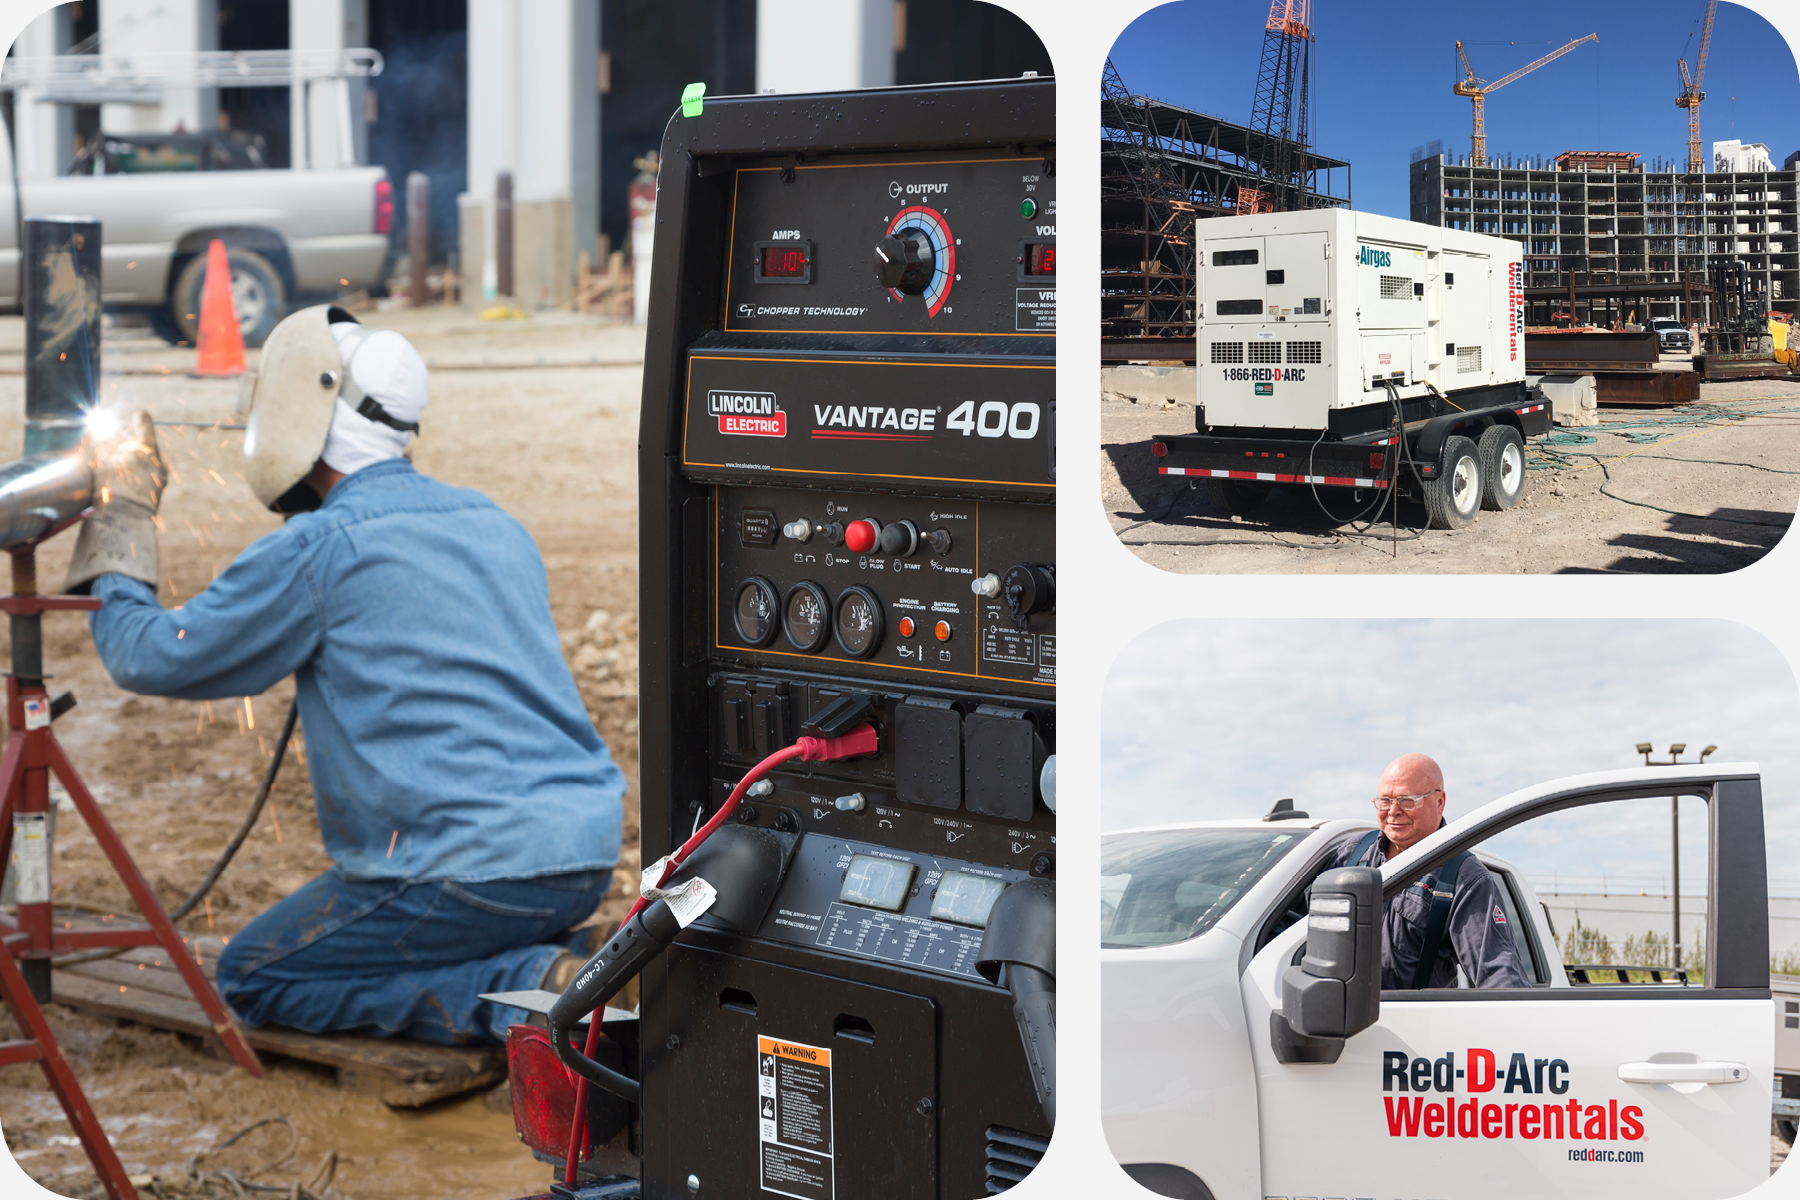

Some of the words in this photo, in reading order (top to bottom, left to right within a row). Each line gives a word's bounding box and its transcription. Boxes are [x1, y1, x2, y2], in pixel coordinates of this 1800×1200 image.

[906, 184, 948, 194] OUTPUT
[772, 230, 800, 240] AMPS
[1360, 246, 1391, 268] Airgas
[1039, 292, 1056, 300] VR
[1508, 262, 1517, 361] Welderentals
[712, 395, 771, 414] LINCOLN
[727, 418, 779, 432] ELECTRIC
[946, 401, 1040, 439] 400
[1008, 829, 1021, 838] 240V
[576, 960, 604, 990] LC-40HD
[782, 1045, 816, 1060] WARNING
[1382, 1048, 1569, 1095] Red-D-Arc
[1383, 1096, 1644, 1141] Welderentals
[1568, 1148, 1644, 1162] reddarc.com
